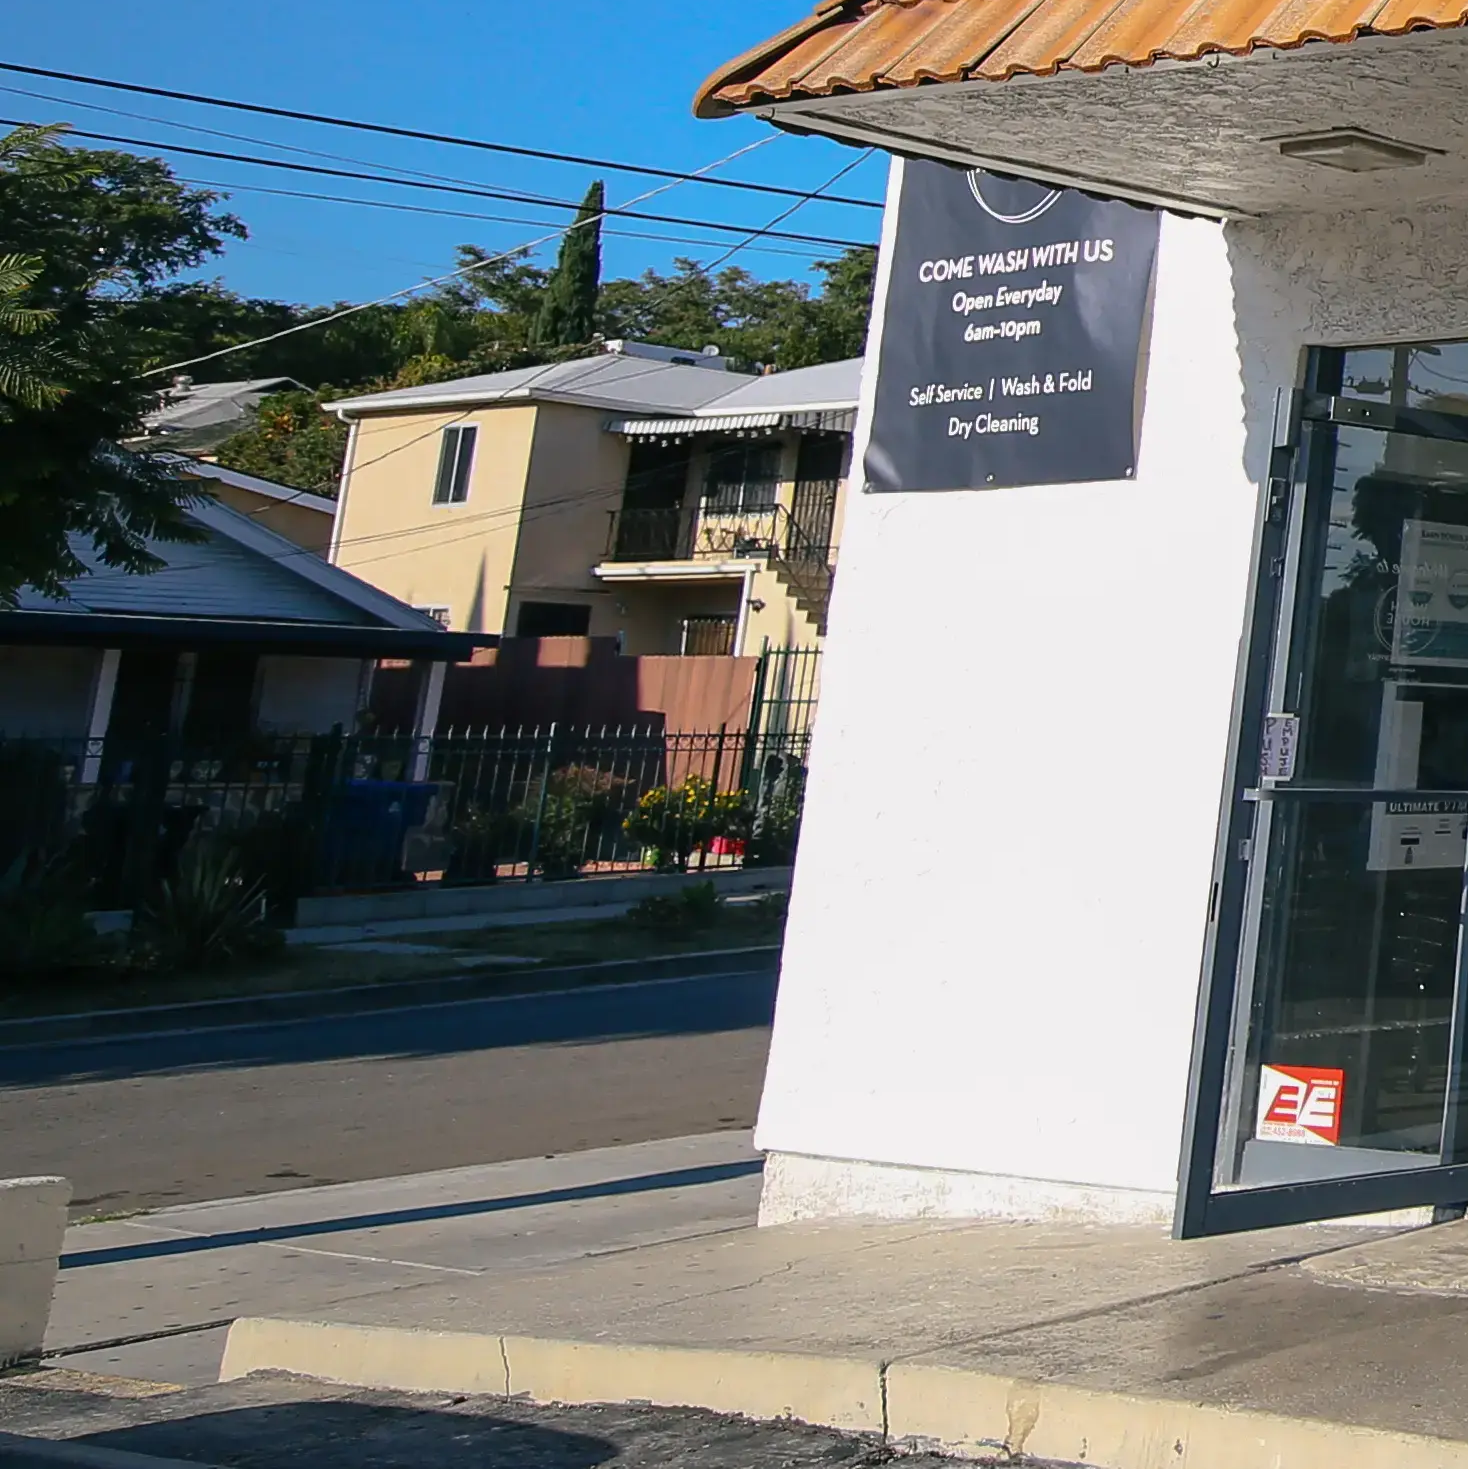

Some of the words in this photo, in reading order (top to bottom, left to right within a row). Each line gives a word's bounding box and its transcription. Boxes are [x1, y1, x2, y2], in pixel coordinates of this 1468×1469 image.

[919, 255, 973, 283] COME
[978, 247, 1029, 275] WASH
[1032, 242, 1078, 267] WITH
[1083, 238, 1115, 263] US
[952, 291, 993, 315] Open
[995, 280, 1063, 308] Everyday
[963, 318, 1041, 343] 6am-10pm
[909, 384, 935, 407] Self
[935, 381, 983, 404] Service
[1001, 377, 1040, 397] Wash
[1043, 374, 1055, 394] &
[1058, 370, 1092, 393] Fold
[948, 415, 973, 440] Dry
[975, 412, 1040, 436] Cleaning
[1278, 718, 1294, 777] EMPUJE
[1389, 801, 1440, 813] ULTIMATE
